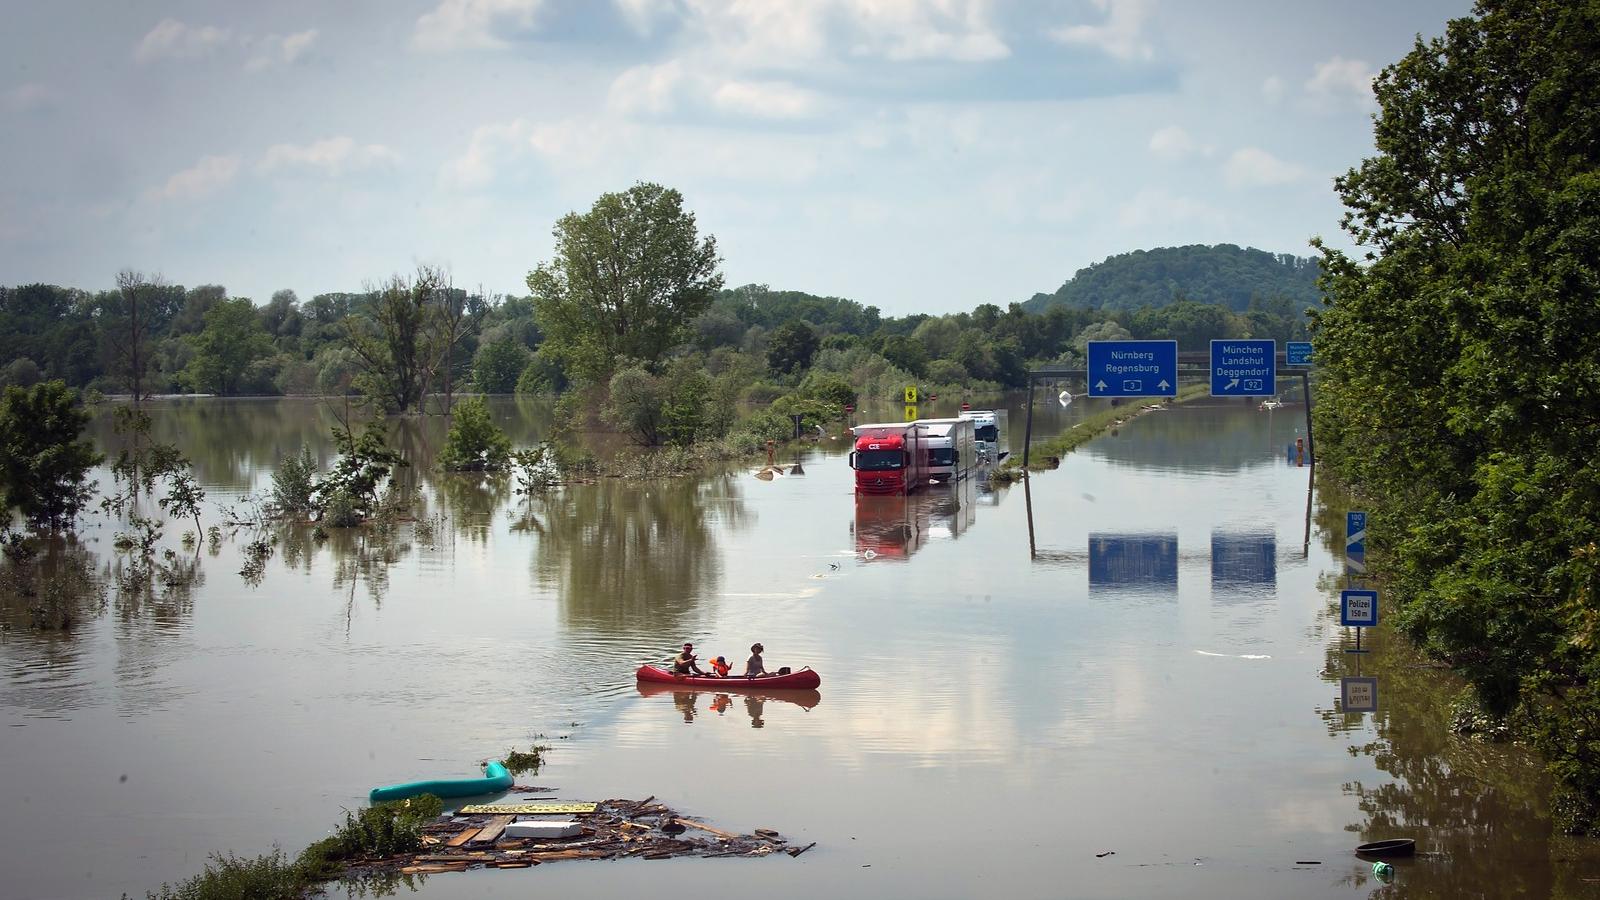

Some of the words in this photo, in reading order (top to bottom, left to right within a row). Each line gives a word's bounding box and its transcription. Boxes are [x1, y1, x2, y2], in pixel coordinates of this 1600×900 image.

[1223, 346, 1263, 354] München
[1111, 351, 1154, 360] Nürnberg
[1106, 364, 1160, 374] Regensburg
[1216, 368, 1270, 378] Deggendorf
[1348, 600, 1370, 608] Polizei
